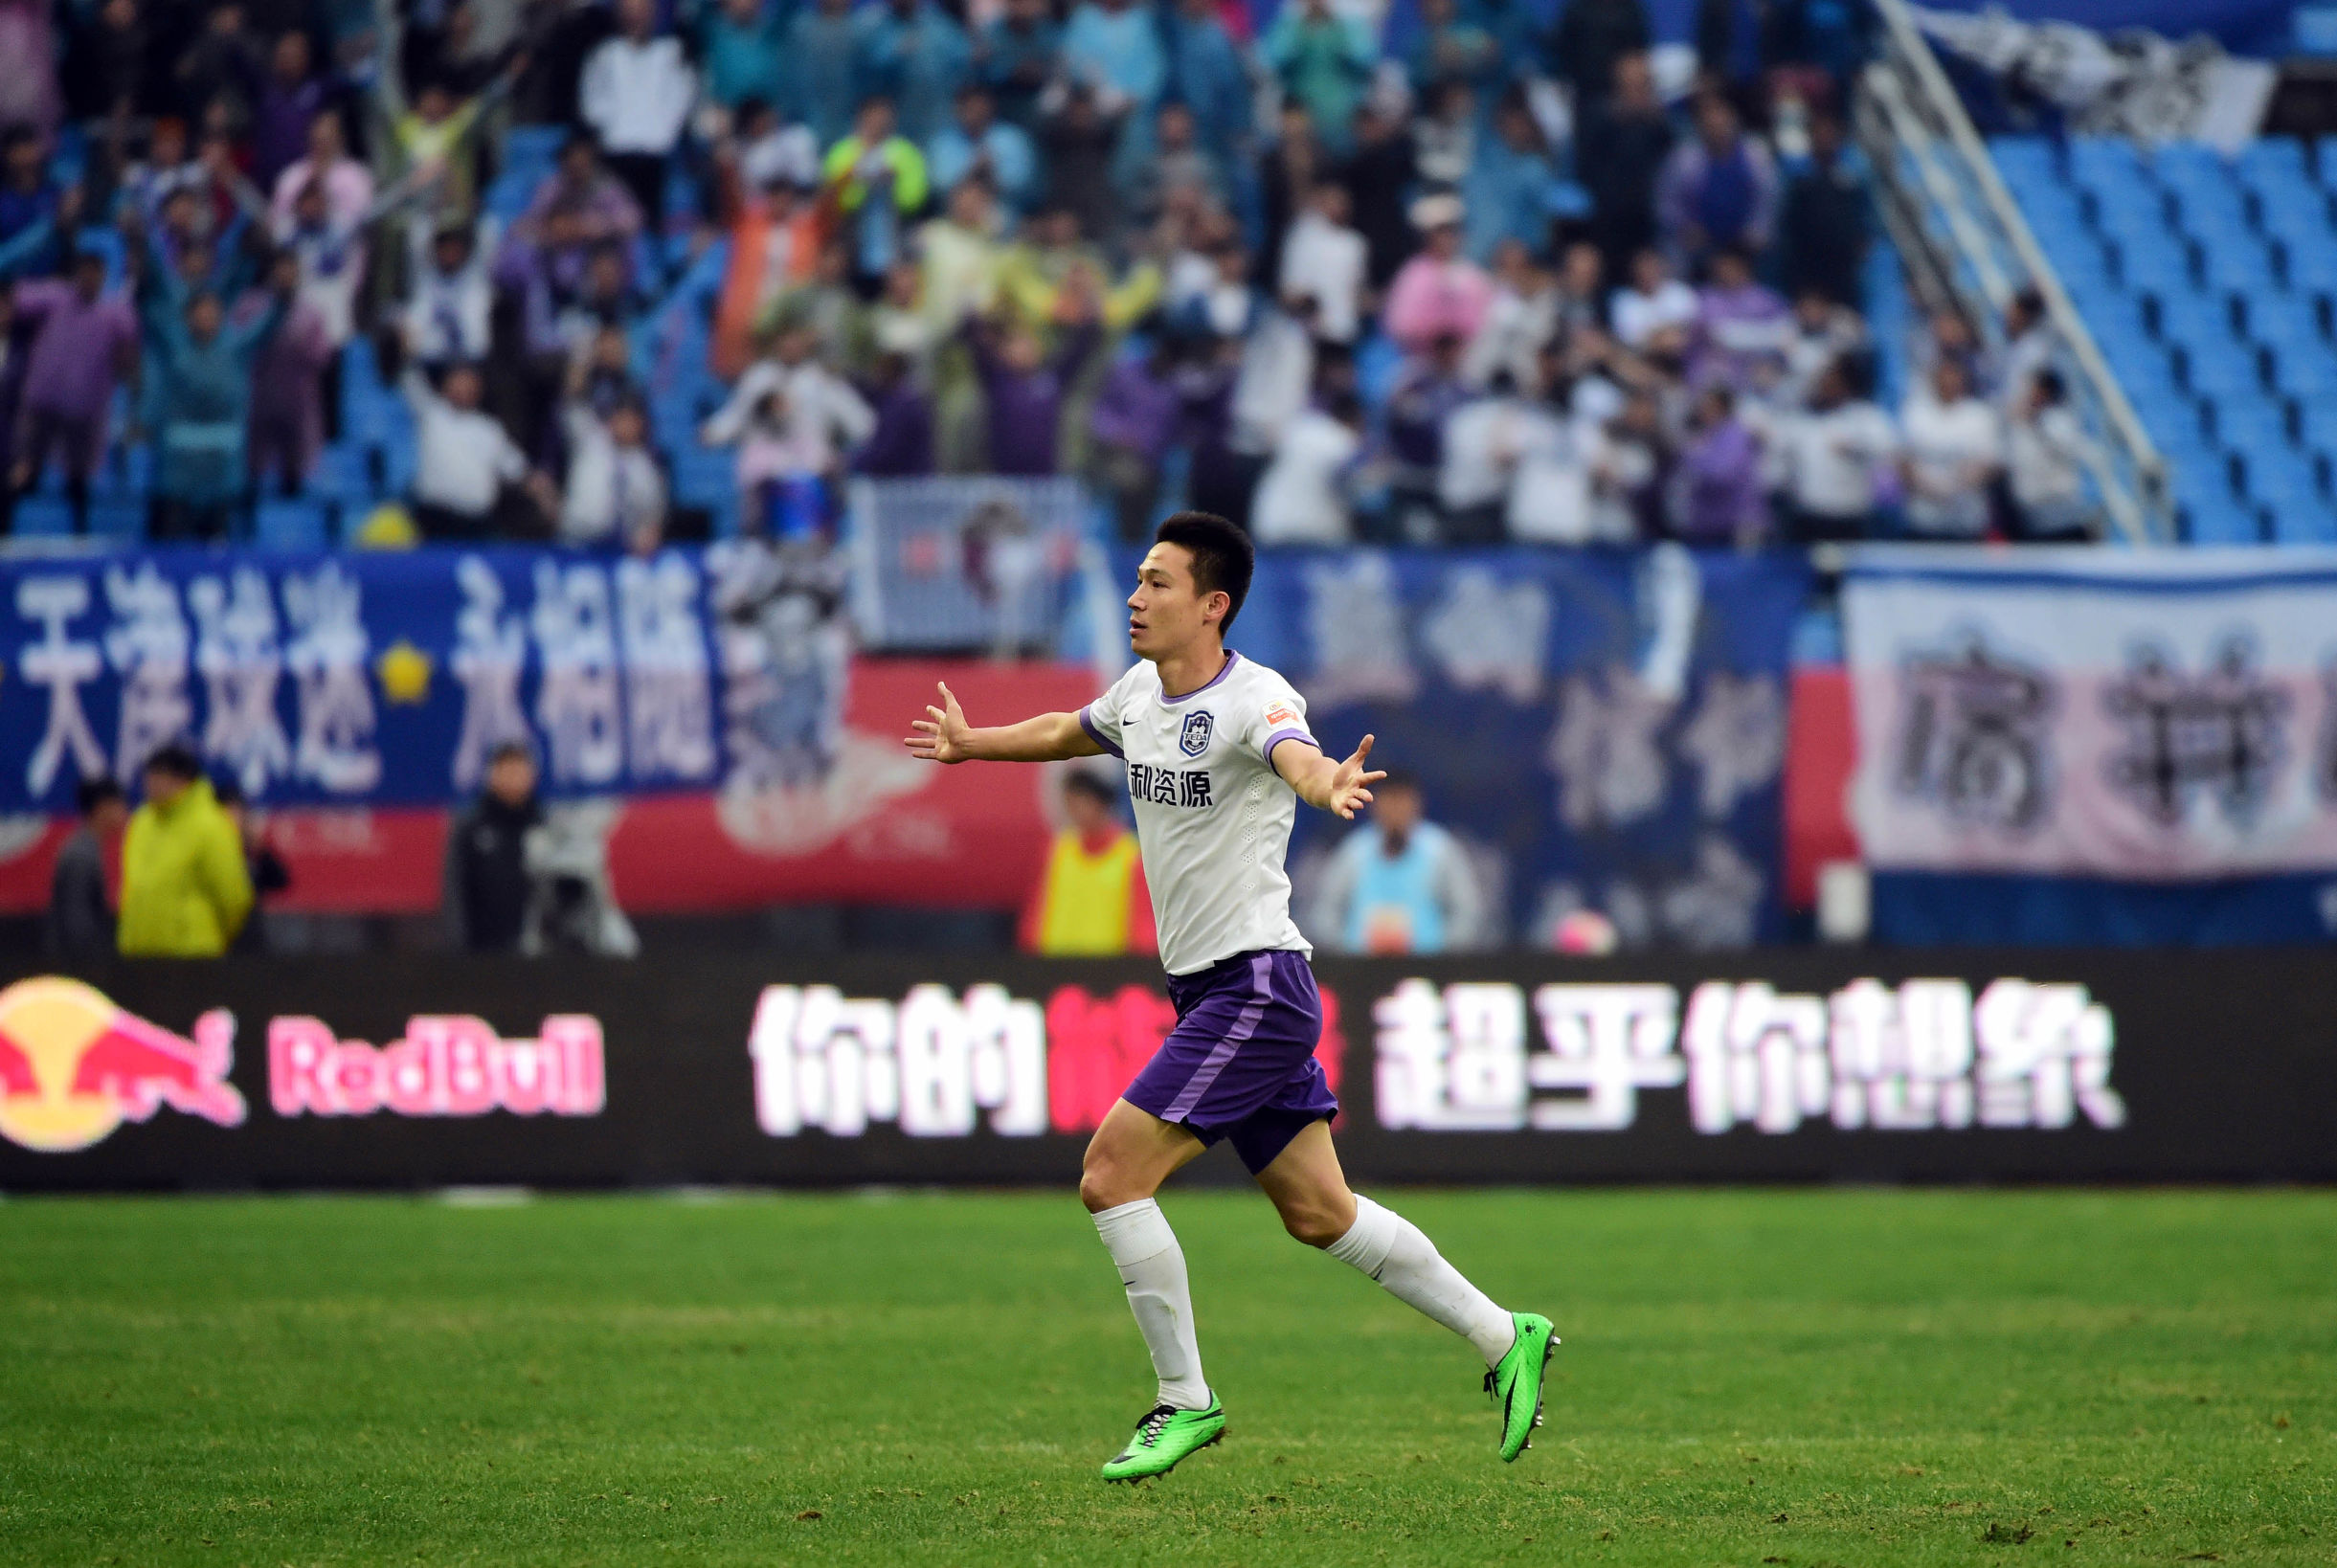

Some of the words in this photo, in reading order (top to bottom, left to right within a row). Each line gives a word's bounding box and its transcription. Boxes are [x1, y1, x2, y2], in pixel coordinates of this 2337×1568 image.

[1127, 762, 1213, 807] 利资源
[1373, 977, 2125, 1133] 超乎你想象
